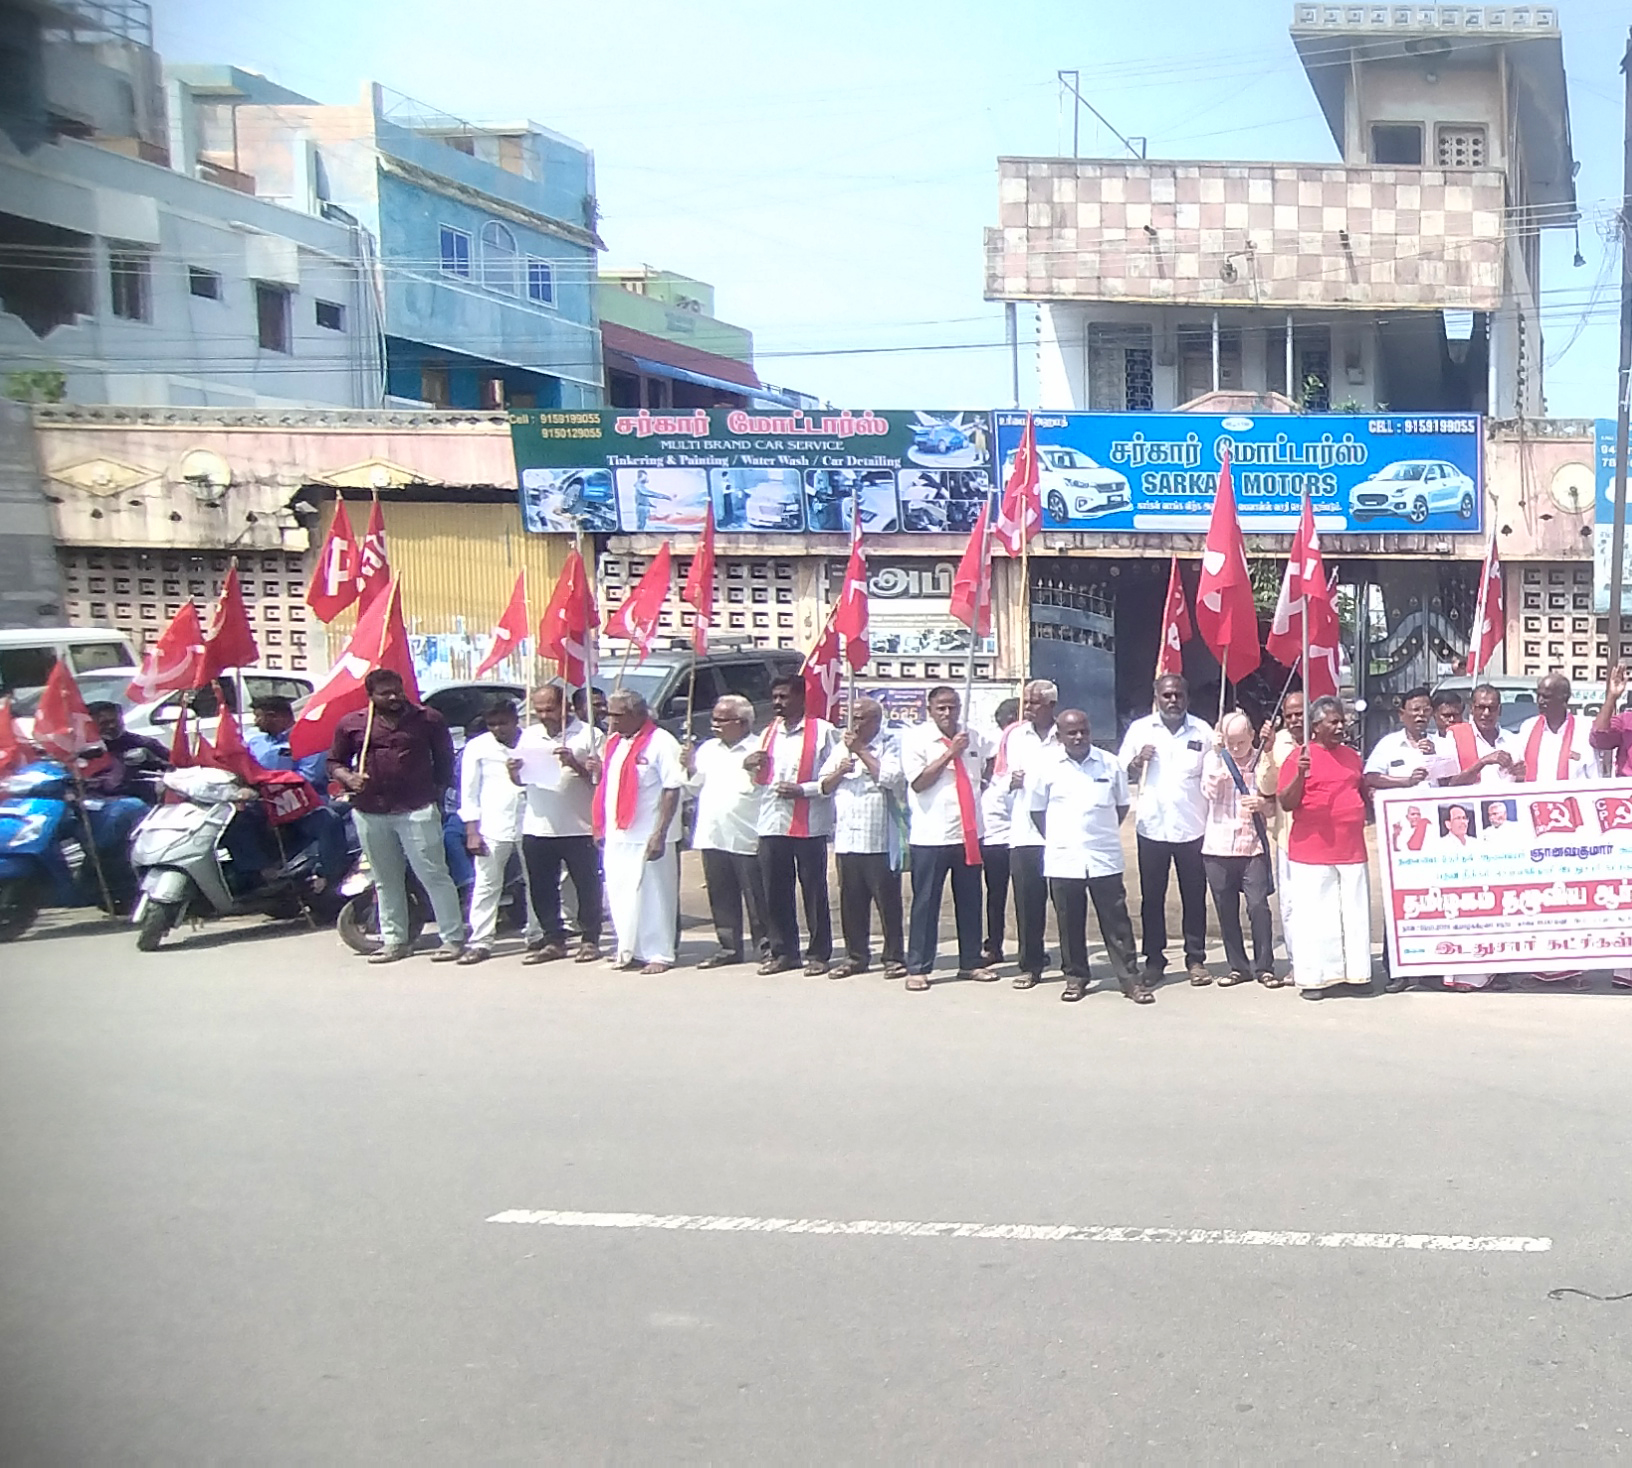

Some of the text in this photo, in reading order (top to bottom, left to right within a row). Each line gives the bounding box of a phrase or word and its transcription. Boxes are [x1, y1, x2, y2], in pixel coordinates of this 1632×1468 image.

[615, 409, 889, 438] சர்கார் மோட்டார்ஸ்
[1368, 420, 1393, 433] CELL
[1404, 420, 1476, 433] 9159199055
[661, 440, 845, 450] MULTI BRAND CAR SERVICE
[1110, 431, 1368, 469] சர்கார் மோட்டார்ஸ்
[606, 455, 664, 467] Tinkering
[666, 456, 677, 466] &
[679, 455, 728, 467] Painting
[741, 455, 776, 466] Water
[777, 455, 809, 466] Wash
[822, 455, 845, 467] Car
[846, 455, 901, 468] Detailing
[1141, 472, 1338, 496] SARKA MOTORS
[1402, 885, 1496, 919] தமிழகம்
[1501, 881, 1588, 916] தழுவிய
